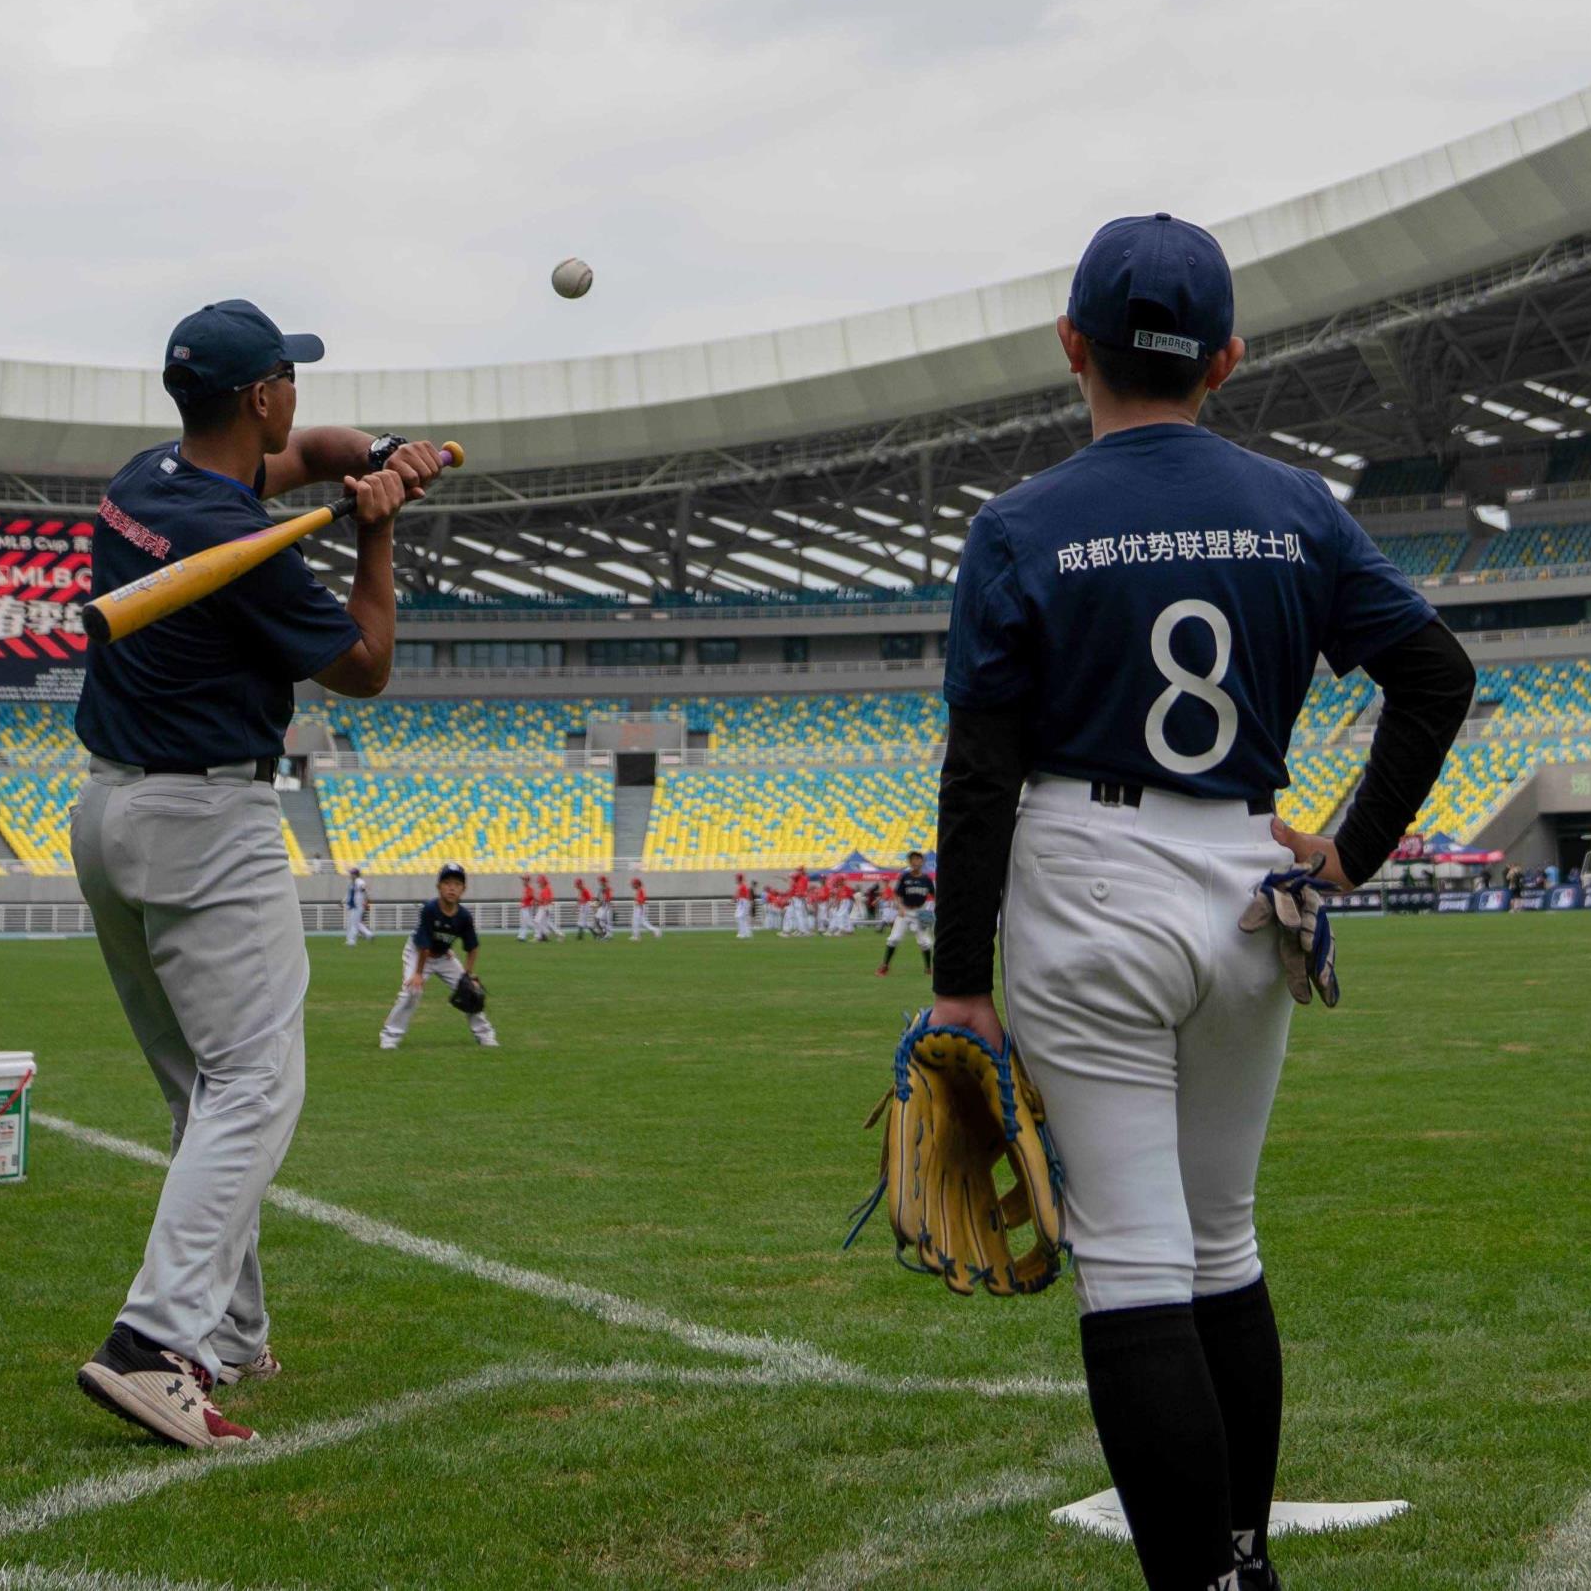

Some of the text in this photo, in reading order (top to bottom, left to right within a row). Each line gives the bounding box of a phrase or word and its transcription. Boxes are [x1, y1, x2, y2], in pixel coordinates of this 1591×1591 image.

[1154, 335, 1192, 354] PADRES
[34, 537, 69, 554] Cup
[1058, 529, 1306, 574] 成都优势联盟教士队
[12, 566, 72, 589] MLB
[1145, 599, 1238, 774] 8
